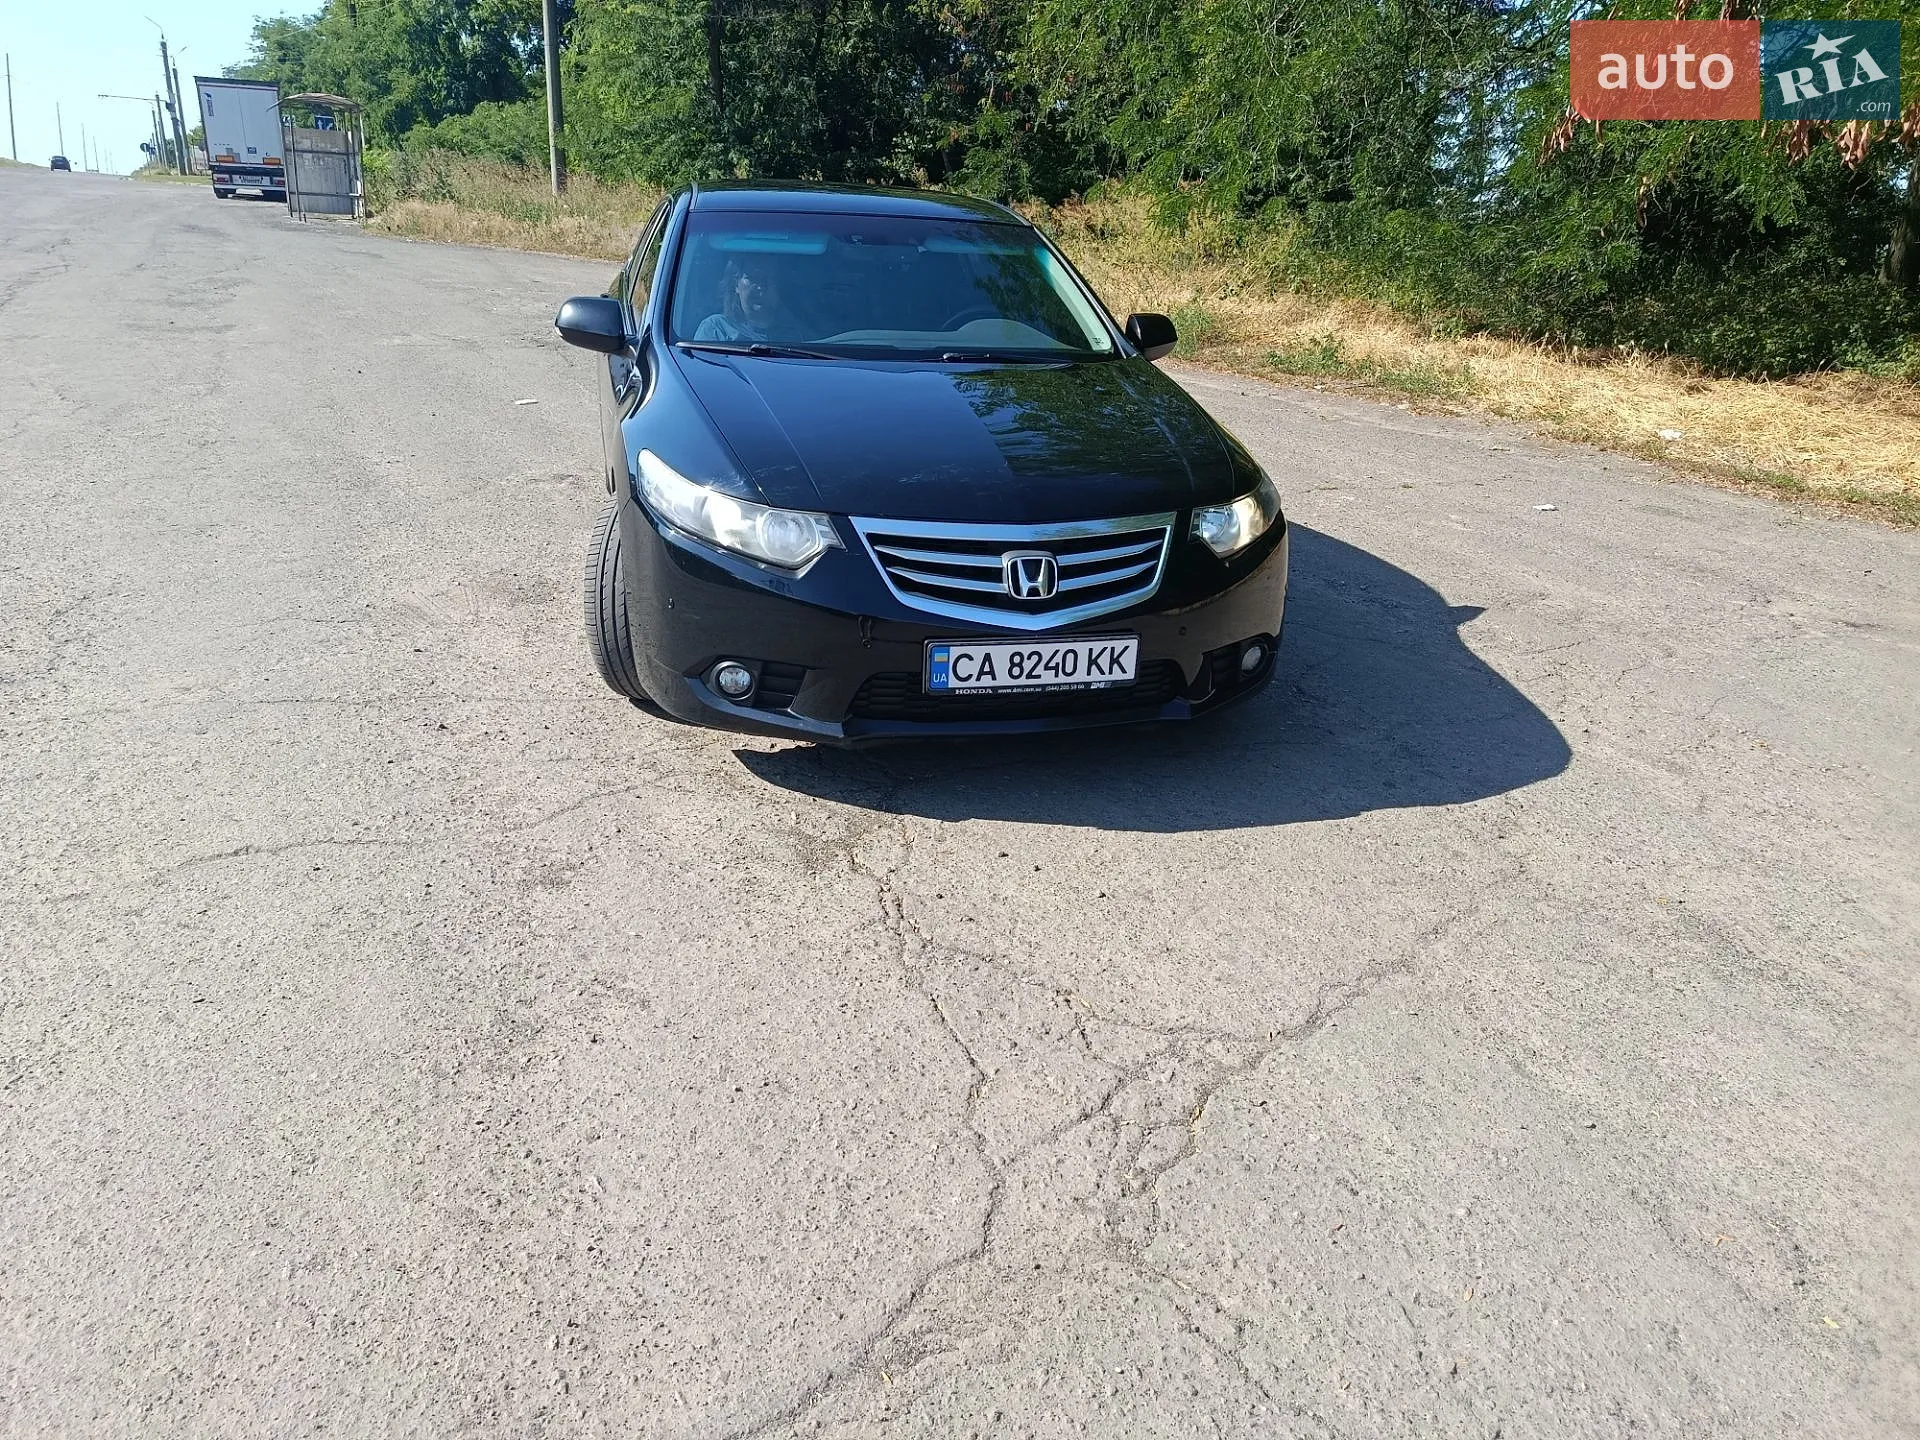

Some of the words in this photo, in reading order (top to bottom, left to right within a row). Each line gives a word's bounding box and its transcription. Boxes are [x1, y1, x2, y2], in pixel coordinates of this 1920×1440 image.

[951, 652, 997, 682] CA
[1007, 648, 1079, 680] 8240
[1086, 645, 1130, 676] KK
[933, 672, 948, 683] UA
